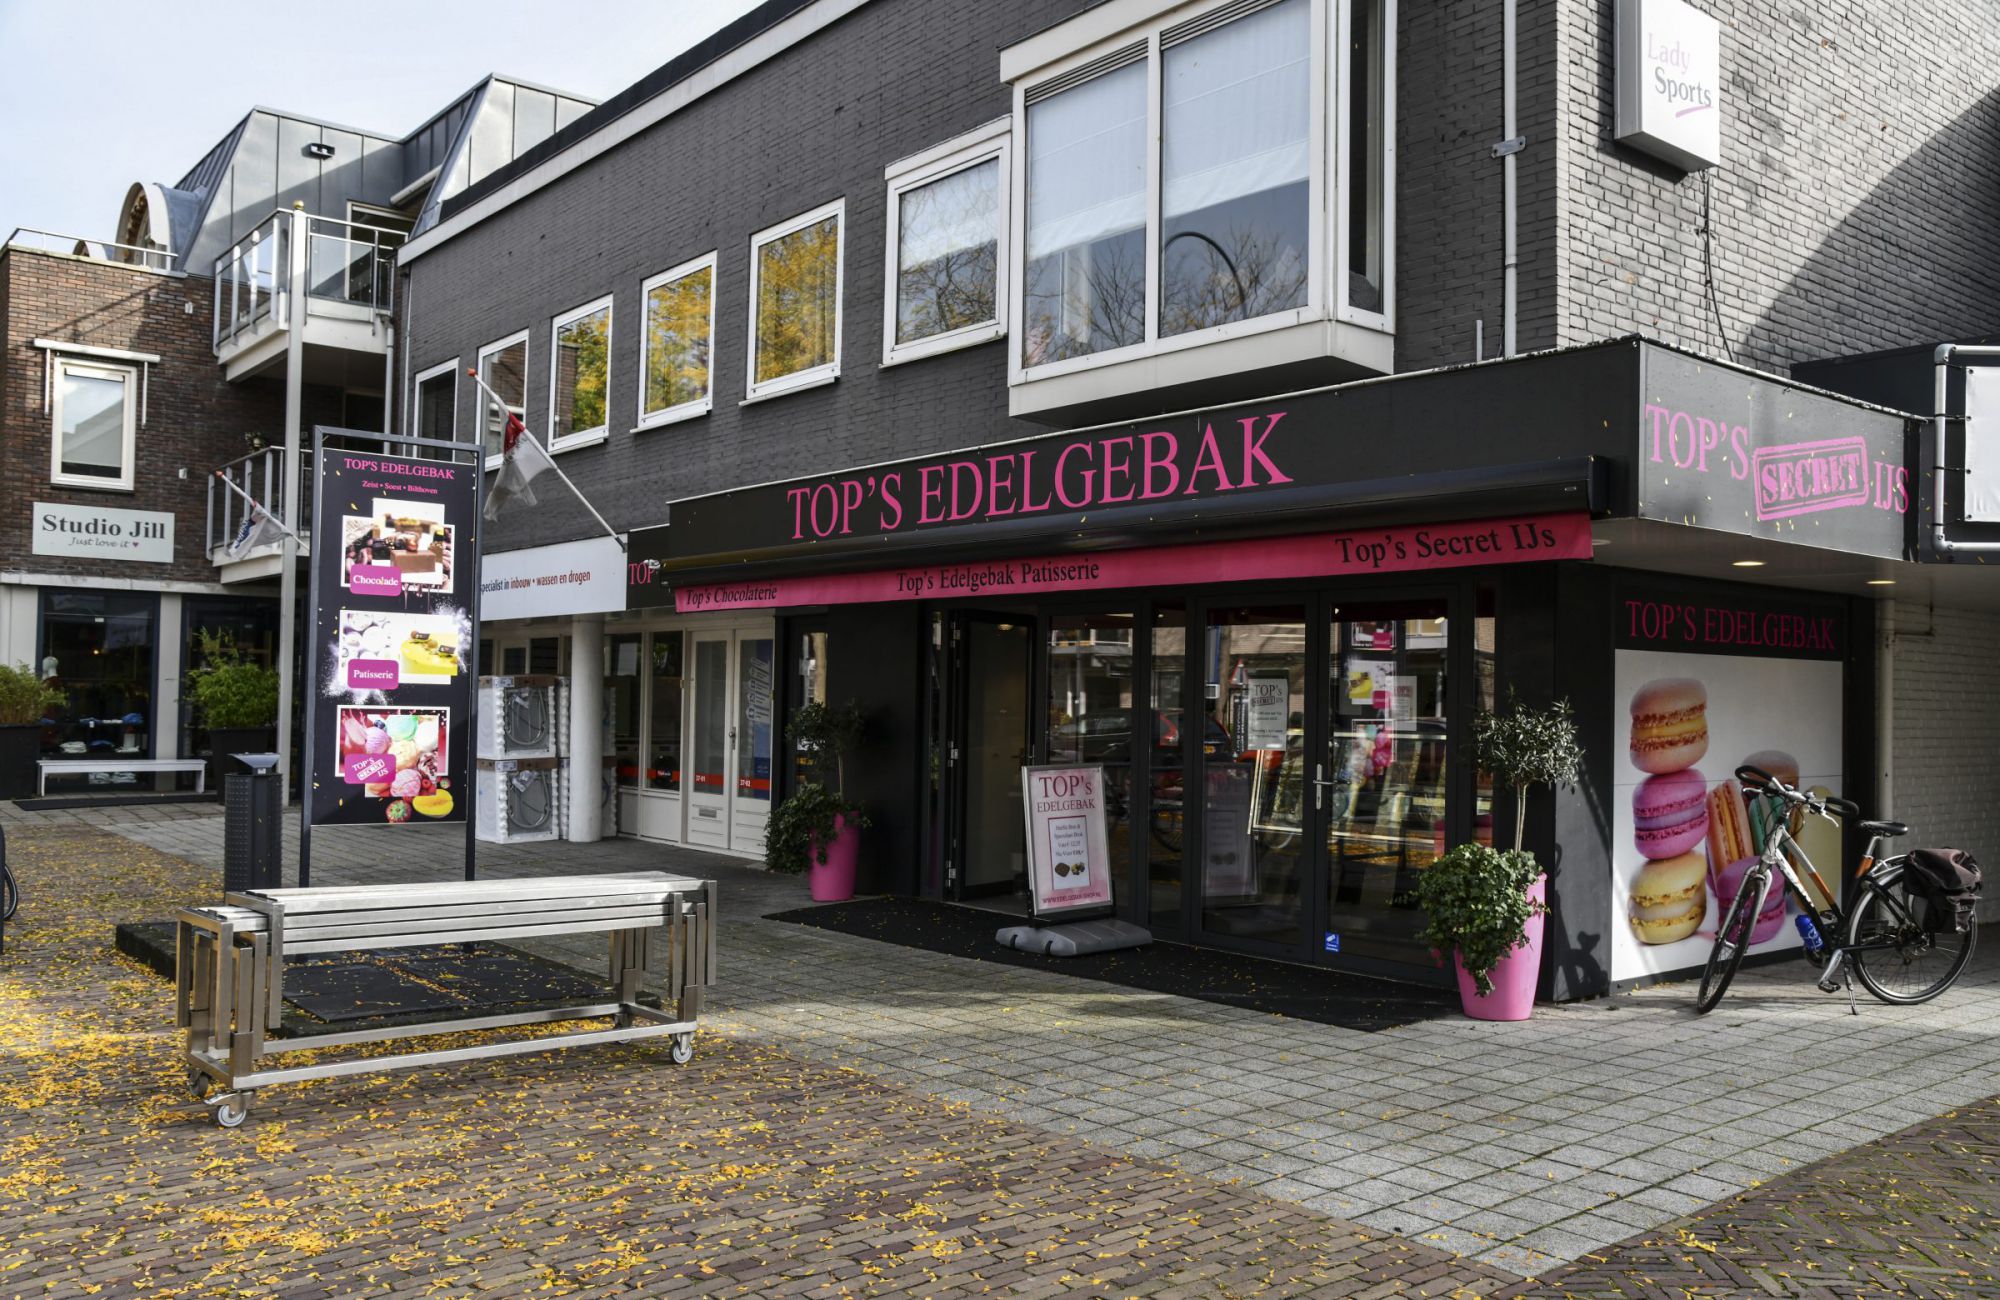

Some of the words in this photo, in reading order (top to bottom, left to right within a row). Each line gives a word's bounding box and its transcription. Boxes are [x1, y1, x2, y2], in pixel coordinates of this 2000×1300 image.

[1648, 32, 1690, 75] Lady
[1655, 66, 1712, 107] Sports
[344, 458, 378, 472] TOP'S
[381, 462, 455, 480] EDELGEBAK
[1644, 403, 1749, 481] TOP'S
[1761, 453, 1860, 504] SECRET
[1872, 460, 1909, 514] IJS
[786, 472, 902, 540] TOP'S
[917, 412, 1294, 525] EDELGEBAK
[362, 480, 379, 489] Zeist
[384, 482, 402, 491] Soest
[407, 484, 438, 495] Bilthoven
[42, 514, 122, 537] Studio
[129, 521, 165, 539] Jill
[68, 537, 94, 547] Just
[95, 538, 118, 548] love
[120, 540, 131, 549] it
[1335, 534, 1406, 568] Top's
[1415, 528, 1502, 558] Secret
[1509, 523, 1556, 549] IJs
[353, 574, 399, 586] Chocolade
[504, 578, 510, 590] in
[510, 577, 532, 590] inbouw
[537, 574, 558, 586] wassen
[559, 574, 568, 584] en
[568, 570, 591, 586] drogen
[896, 569, 933, 595] Top's
[939, 562, 1015, 592] Edelgebak
[1021, 557, 1099, 584] Patisserie
[685, 588, 711, 605] Top's
[714, 583, 778, 604] Chocolaterie
[1625, 600, 1697, 641] TOP'S
[1703, 608, 1835, 649] EDELGEBAK
[353, 669, 394, 680] Patisserie
[352, 757, 375, 771] TOP'S
[1039, 775, 1093, 798] TOP's
[1037, 799, 1096, 813] EDELGEBAK
